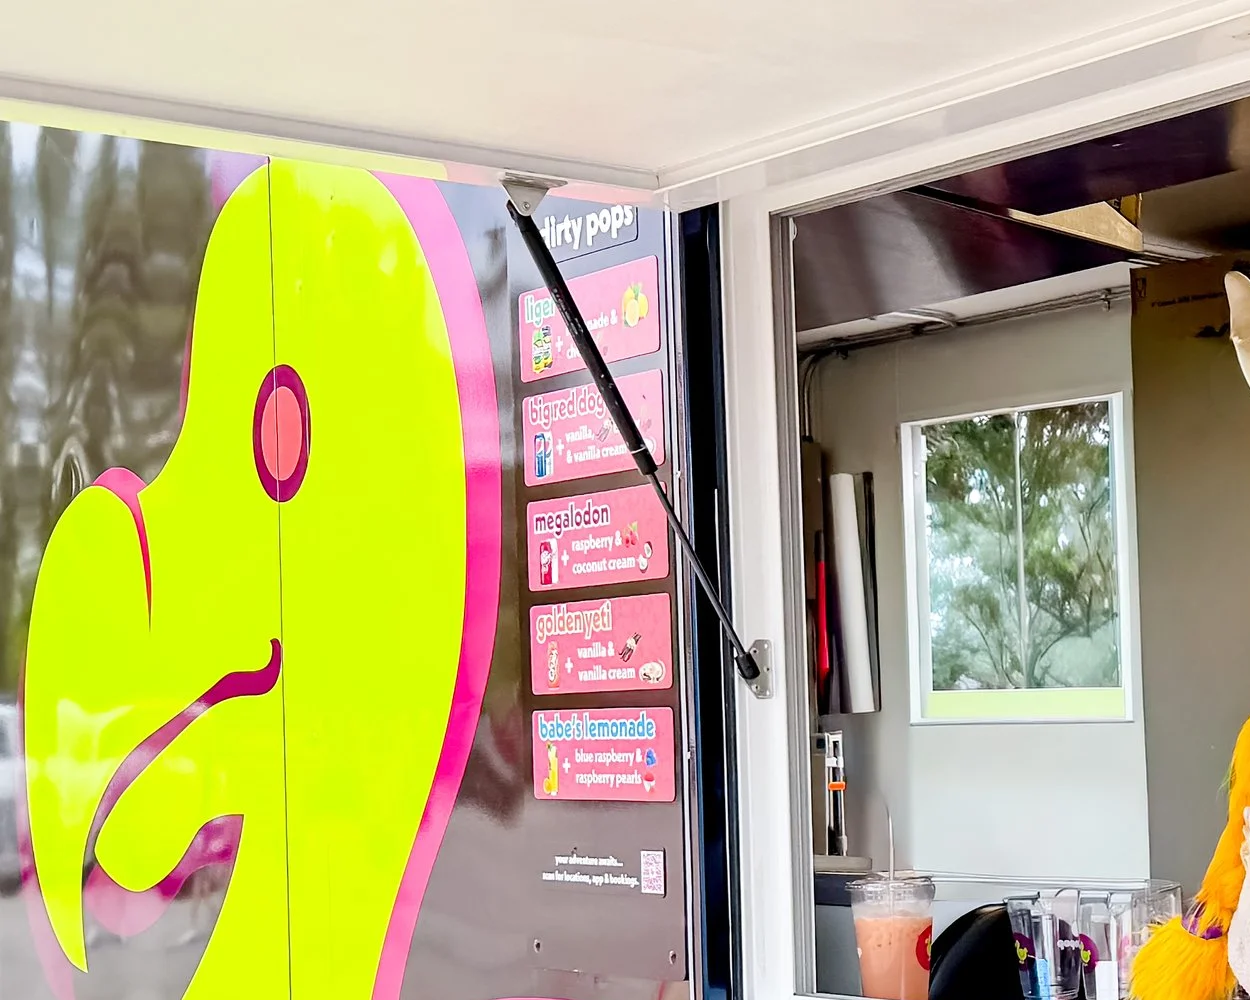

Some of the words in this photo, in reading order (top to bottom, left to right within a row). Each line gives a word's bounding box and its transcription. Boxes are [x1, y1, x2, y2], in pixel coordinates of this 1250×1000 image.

[540, 214, 583, 250] dirty
[585, 204, 634, 247] pops
[610, 309, 618, 326] &
[529, 397, 552, 430] big
[552, 387, 576, 421] red
[577, 385, 607, 419] dog
[566, 450, 573, 464] &
[574, 445, 600, 463] vanilla
[534, 499, 610, 539] megalodon
[572, 534, 614, 555] raspberry
[614, 530, 622, 547] &
[572, 558, 607, 575] coconut
[608, 556, 635, 571] cream
[536, 604, 584, 644] golden
[583, 599, 613, 640] yeti
[577, 642, 606, 659] vanilla
[607, 641, 615, 657] &
[578, 665, 607, 681] vanilla
[608, 667, 636, 680] cream
[538, 712, 583, 741] babe's
[583, 710, 656, 741] lemonade
[575, 748, 594, 763] blue
[594, 748, 635, 767] raspberry
[576, 769, 615, 788] raspberry
[615, 769, 642, 788] pearls
